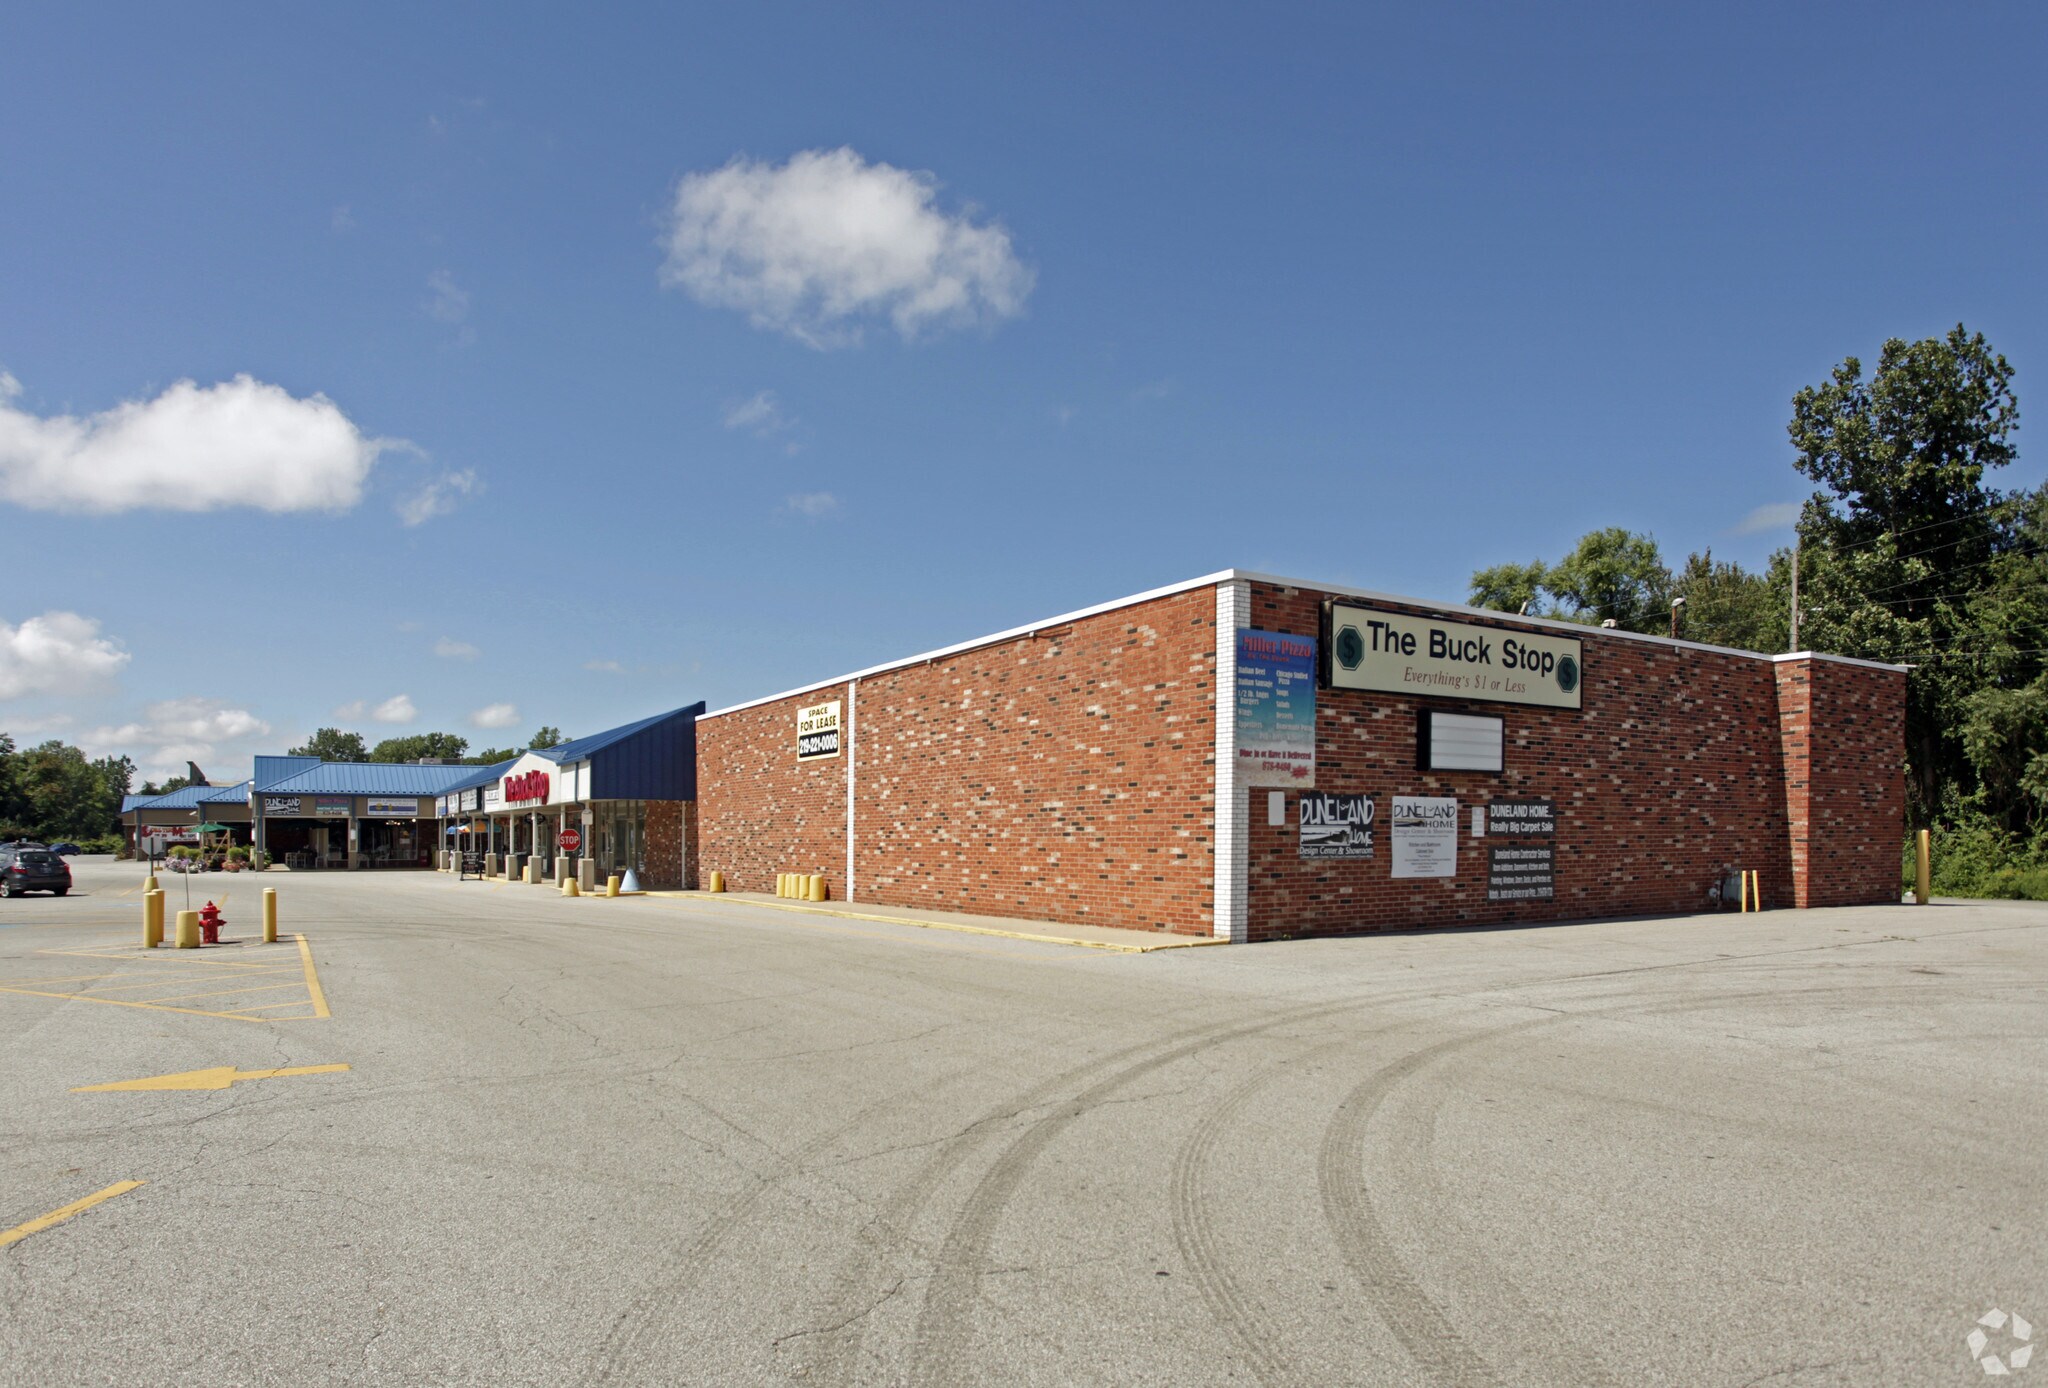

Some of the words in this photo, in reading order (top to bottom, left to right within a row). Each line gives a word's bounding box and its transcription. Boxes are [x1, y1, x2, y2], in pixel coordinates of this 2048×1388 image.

[1242, 635, 1277, 654] Miller
[1281, 639, 1312, 657] Pizza
[1367, 620, 1416, 656] The
[1430, 629, 1491, 664] Buck
[1502, 638, 1555, 677] Stop
[1404, 666, 1470, 690] Everything's
[1475, 673, 1487, 690] $1
[1491, 680, 1500, 689] or
[1505, 677, 1526, 693] Less
[1238, 689, 1247, 697] 1/2
[808, 707, 828, 718] SPACE
[800, 720, 814, 732] FOR
[816, 715, 836, 729] LEASE
[1300, 794, 1375, 825] DUNELAND
[1394, 802, 1455, 819] DUNELAND
[1490, 804, 1528, 818] DUNELAND
[1424, 820, 1455, 829] HOME
[1490, 821, 1509, 833] Really
[1509, 821, 1520, 833] Big
[1520, 821, 1540, 833] Carpet
[1541, 822, 1553, 832] Sale
[560, 835, 579, 845] STOP
